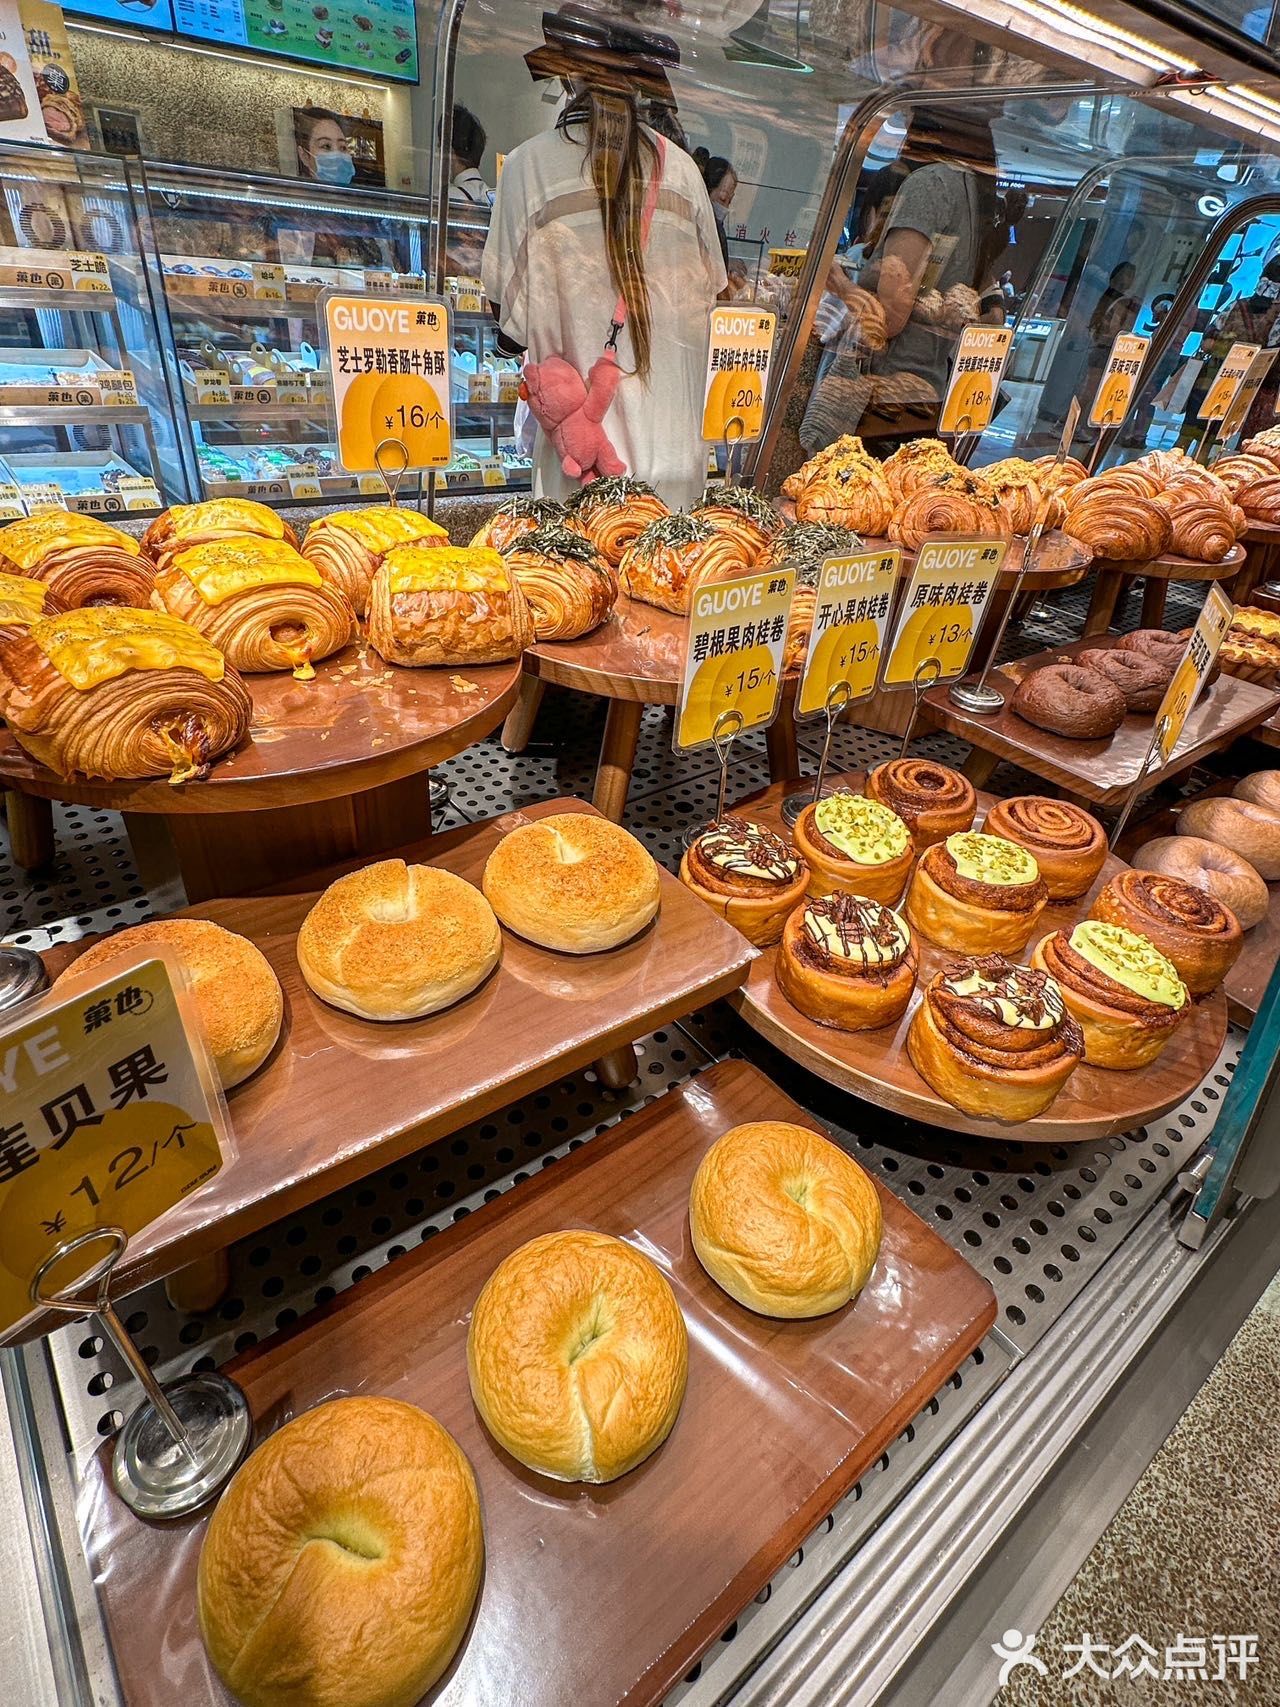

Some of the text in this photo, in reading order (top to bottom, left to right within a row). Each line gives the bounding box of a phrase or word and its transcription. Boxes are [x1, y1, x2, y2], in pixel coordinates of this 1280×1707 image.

[736, 224, 797, 247] 消火栓
[70, 258, 108, 274] 芝士脆
[333, 304, 410, 333] GUOYE
[715, 316, 756, 337] GUOYE
[964, 332, 995, 348] GUOYE
[337, 346, 446, 376] 芝士罗勒香肠牛角酥
[711, 348, 769, 373] 黑胡椒牛肉牛角酥
[1108, 358, 1140, 376] 原味可颂
[922, 548, 979, 570] GUOYE
[825, 561, 876, 587] GUOYE
[696, 582, 763, 618] GUOYE
[910, 580, 988, 609] 原味肉桂卷
[817, 592, 889, 631] 开心果肉桂卷
[693, 614, 785, 663] 碧根果肉桂卷
[84, 985, 146, 1034] 菓也
